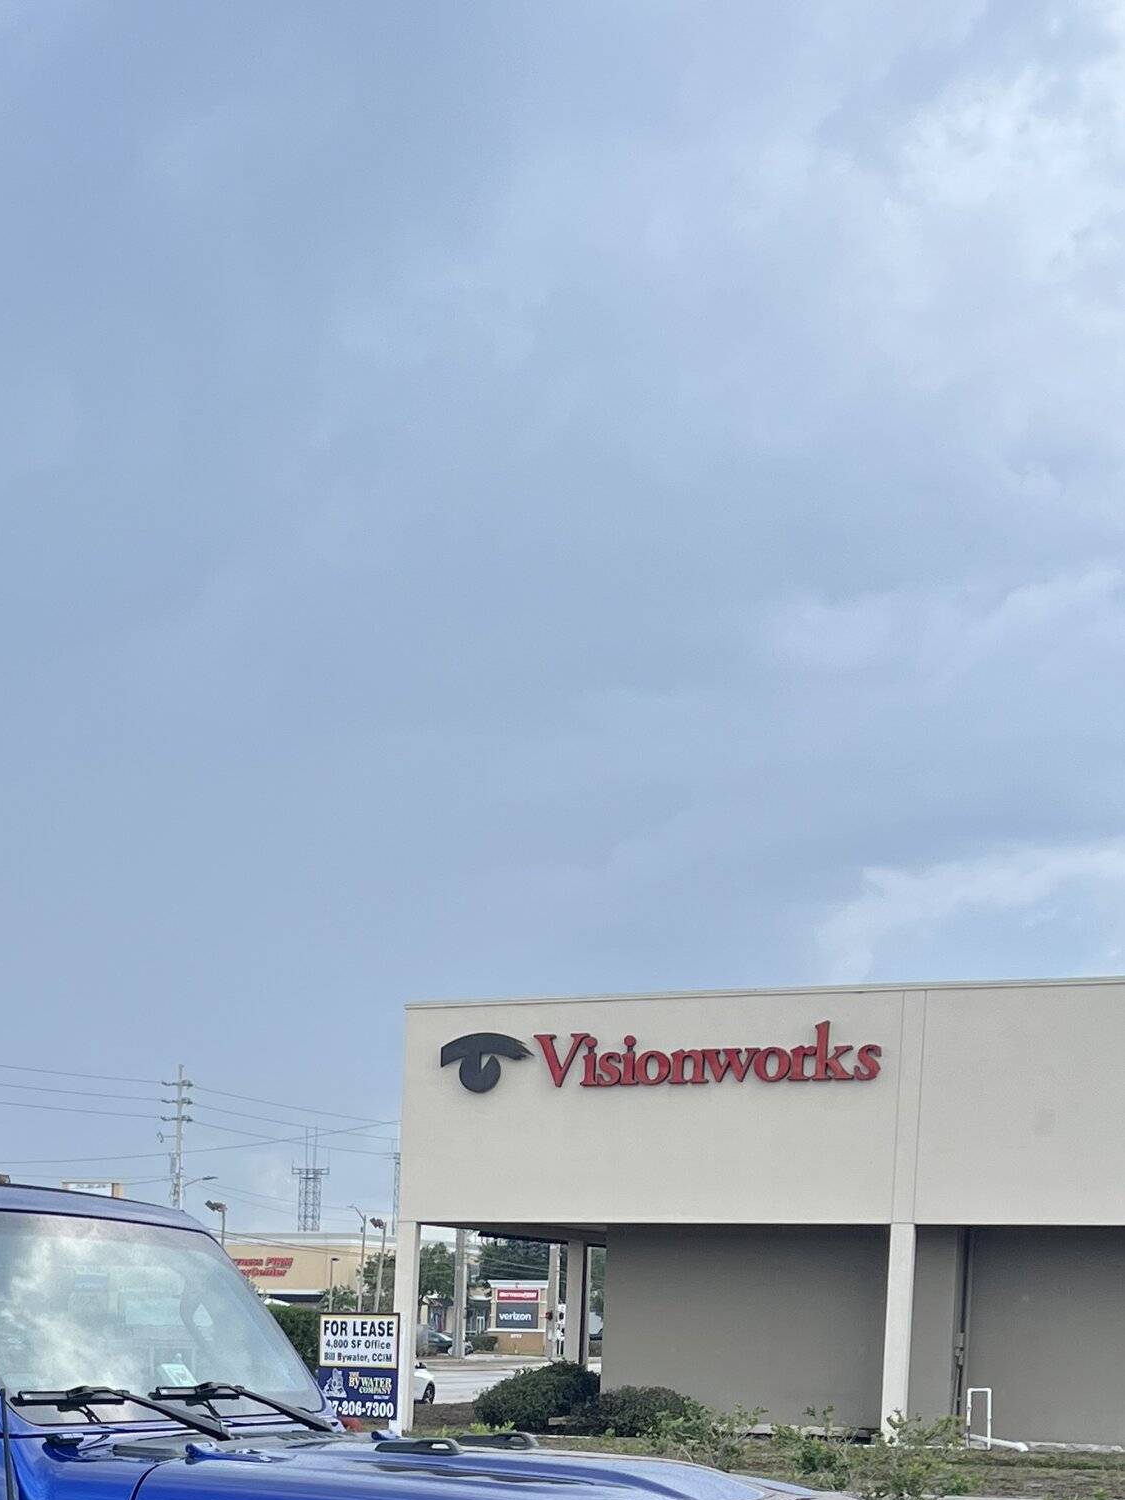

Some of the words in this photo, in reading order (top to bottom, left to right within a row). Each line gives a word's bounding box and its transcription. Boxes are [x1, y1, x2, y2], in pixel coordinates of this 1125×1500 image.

[534, 1020, 881, 1087] Visionworks
[499, 1311, 532, 1320] verizon
[323, 1320, 348, 1336] FOR
[353, 1321, 394, 1337] LEASE
[351, 1340, 362, 1349] SF
[364, 1340, 391, 1350] Office
